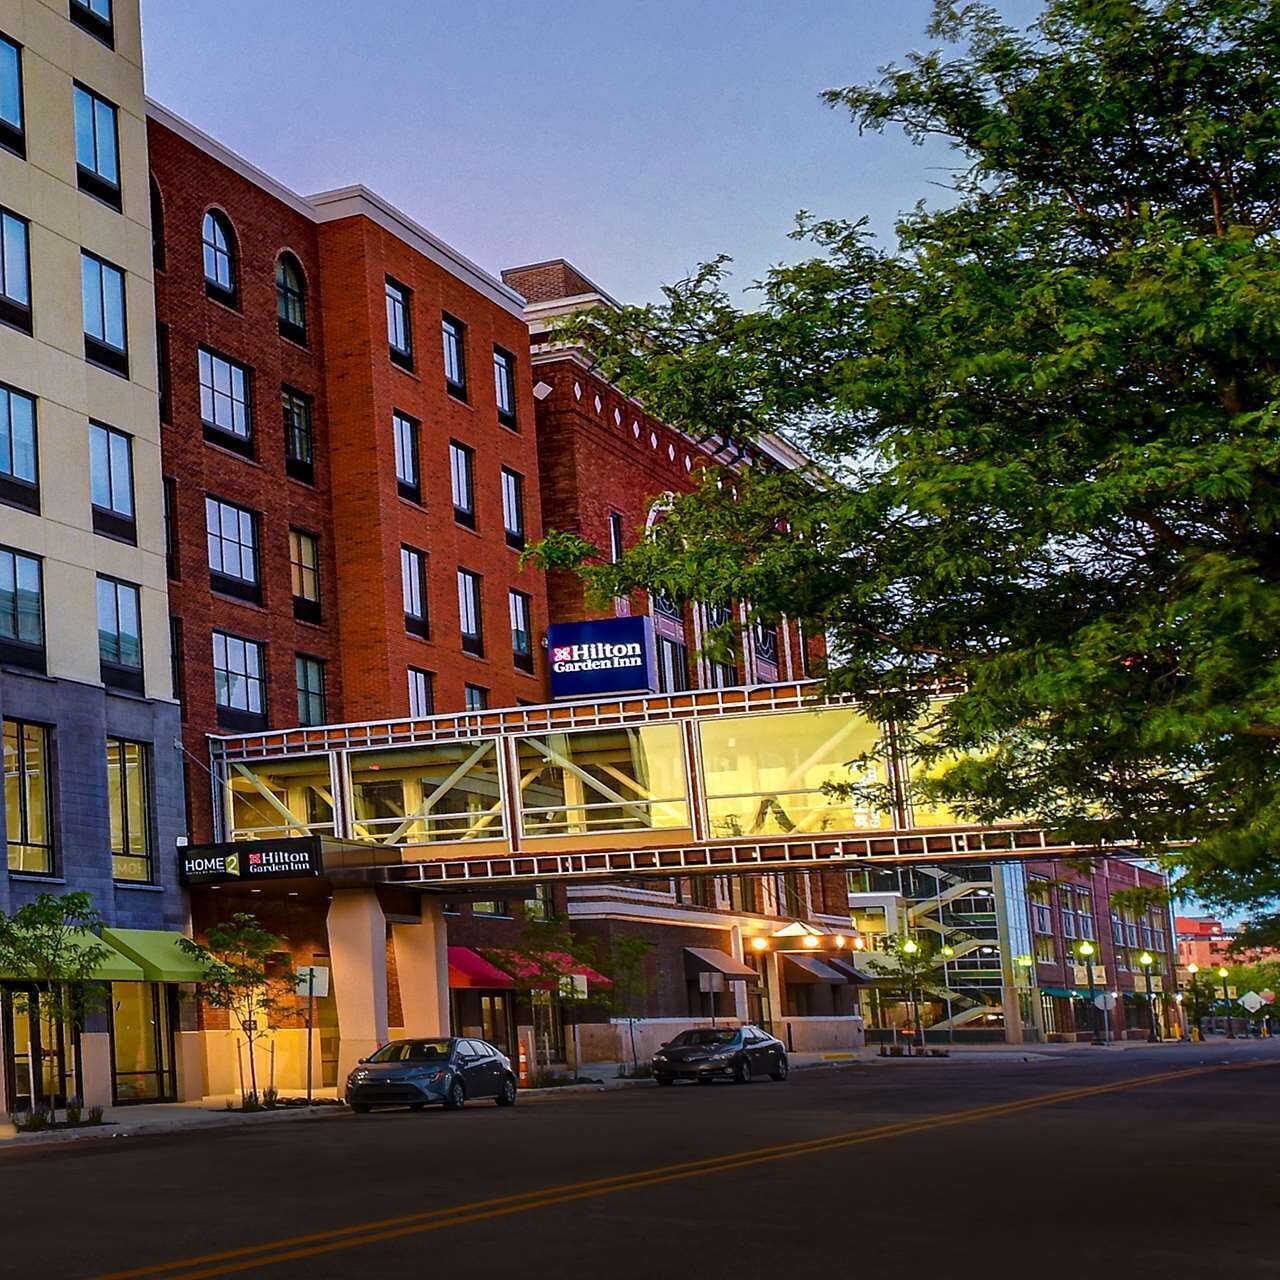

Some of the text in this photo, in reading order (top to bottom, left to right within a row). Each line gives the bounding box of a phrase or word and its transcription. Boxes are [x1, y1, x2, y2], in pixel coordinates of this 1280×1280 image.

[572, 642, 642, 661] Hilton
[553, 656, 642, 673] Garden Inn
[261, 851, 310, 864] Hilton
[249, 860, 310, 873] Garden Inn
